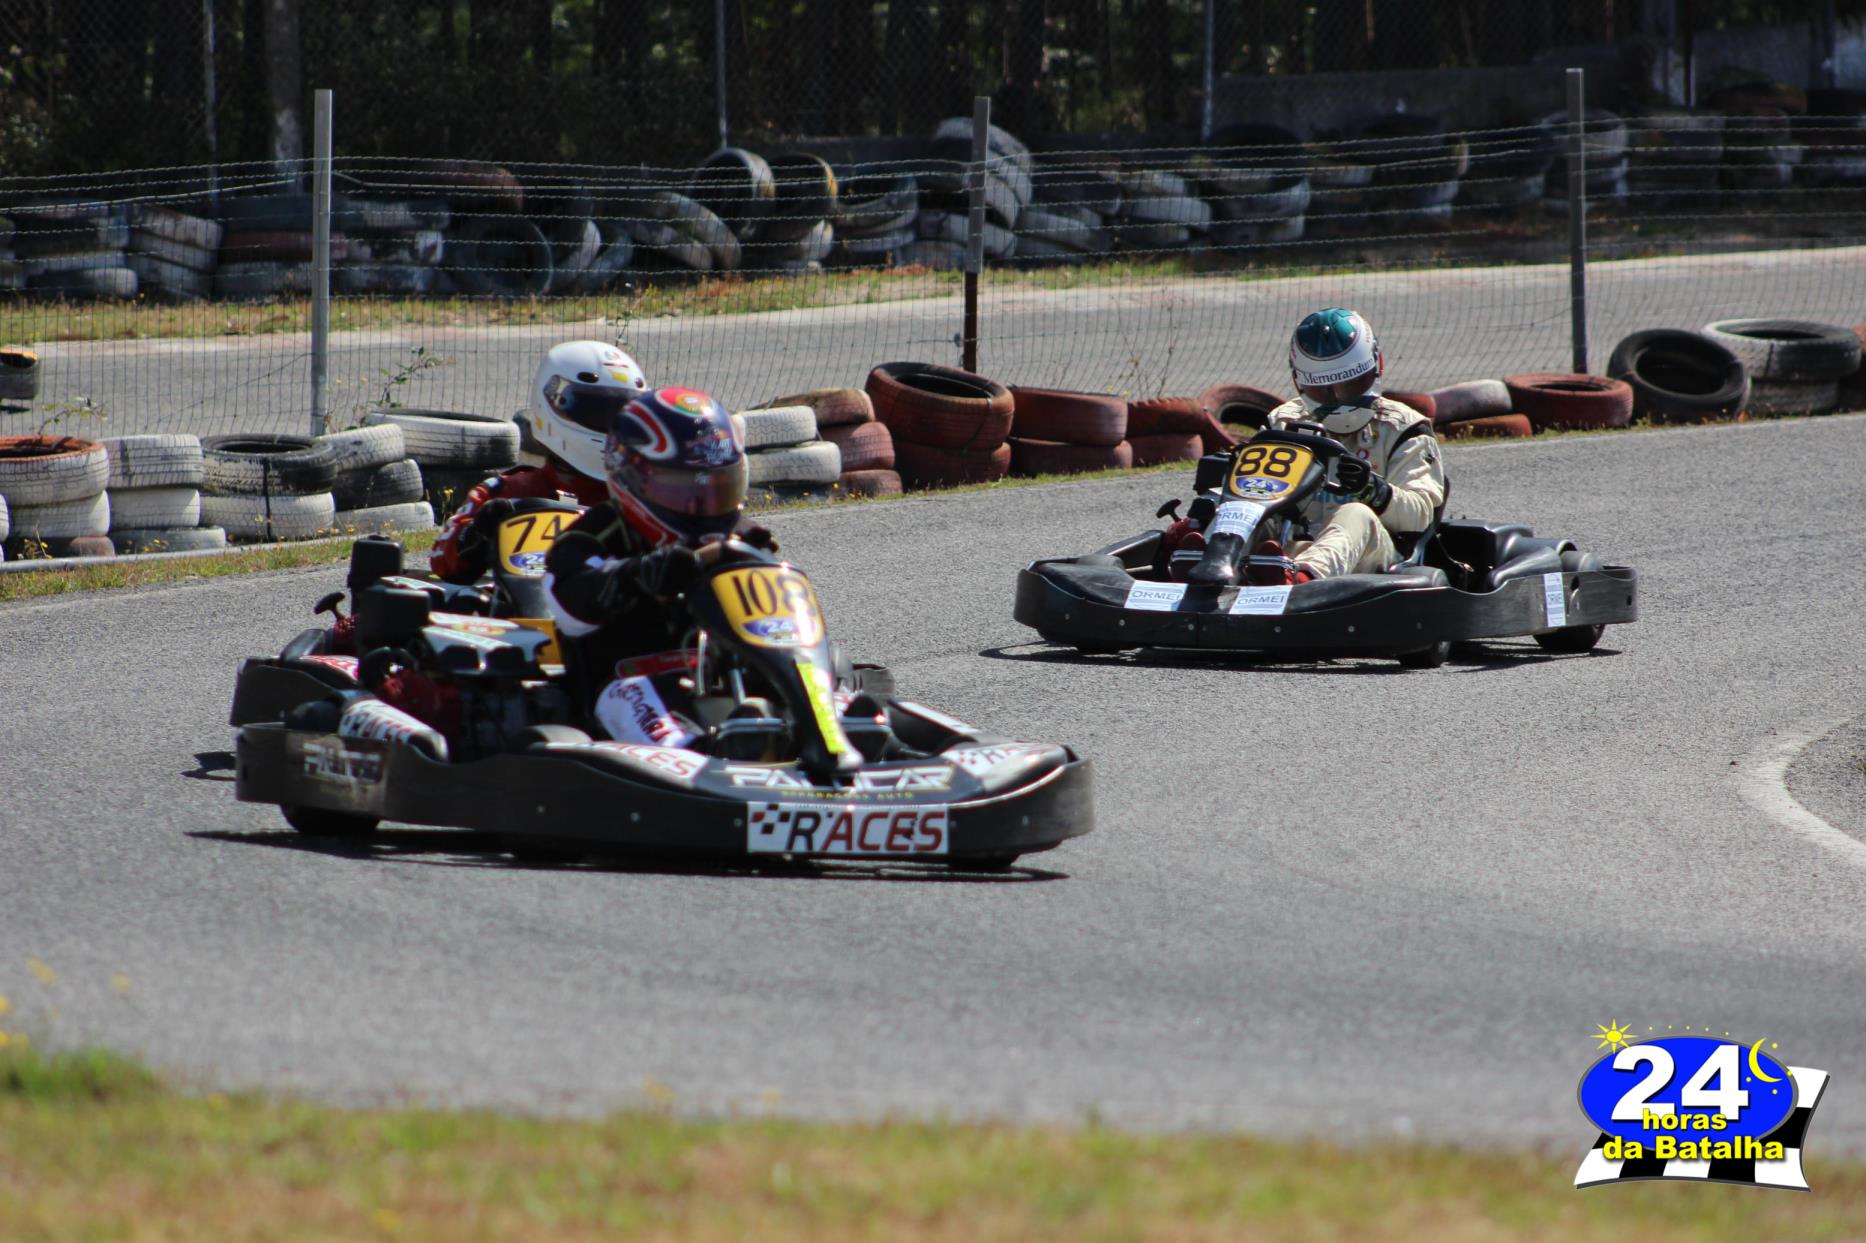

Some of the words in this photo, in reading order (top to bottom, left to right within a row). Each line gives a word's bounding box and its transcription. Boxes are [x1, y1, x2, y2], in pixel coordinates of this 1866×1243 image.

[1303, 357, 1374, 385] Memorandum
[1235, 447, 1297, 477] 88
[506, 514, 562, 554] 74
[731, 570, 817, 617] 108
[785, 811, 946, 852] RACES
